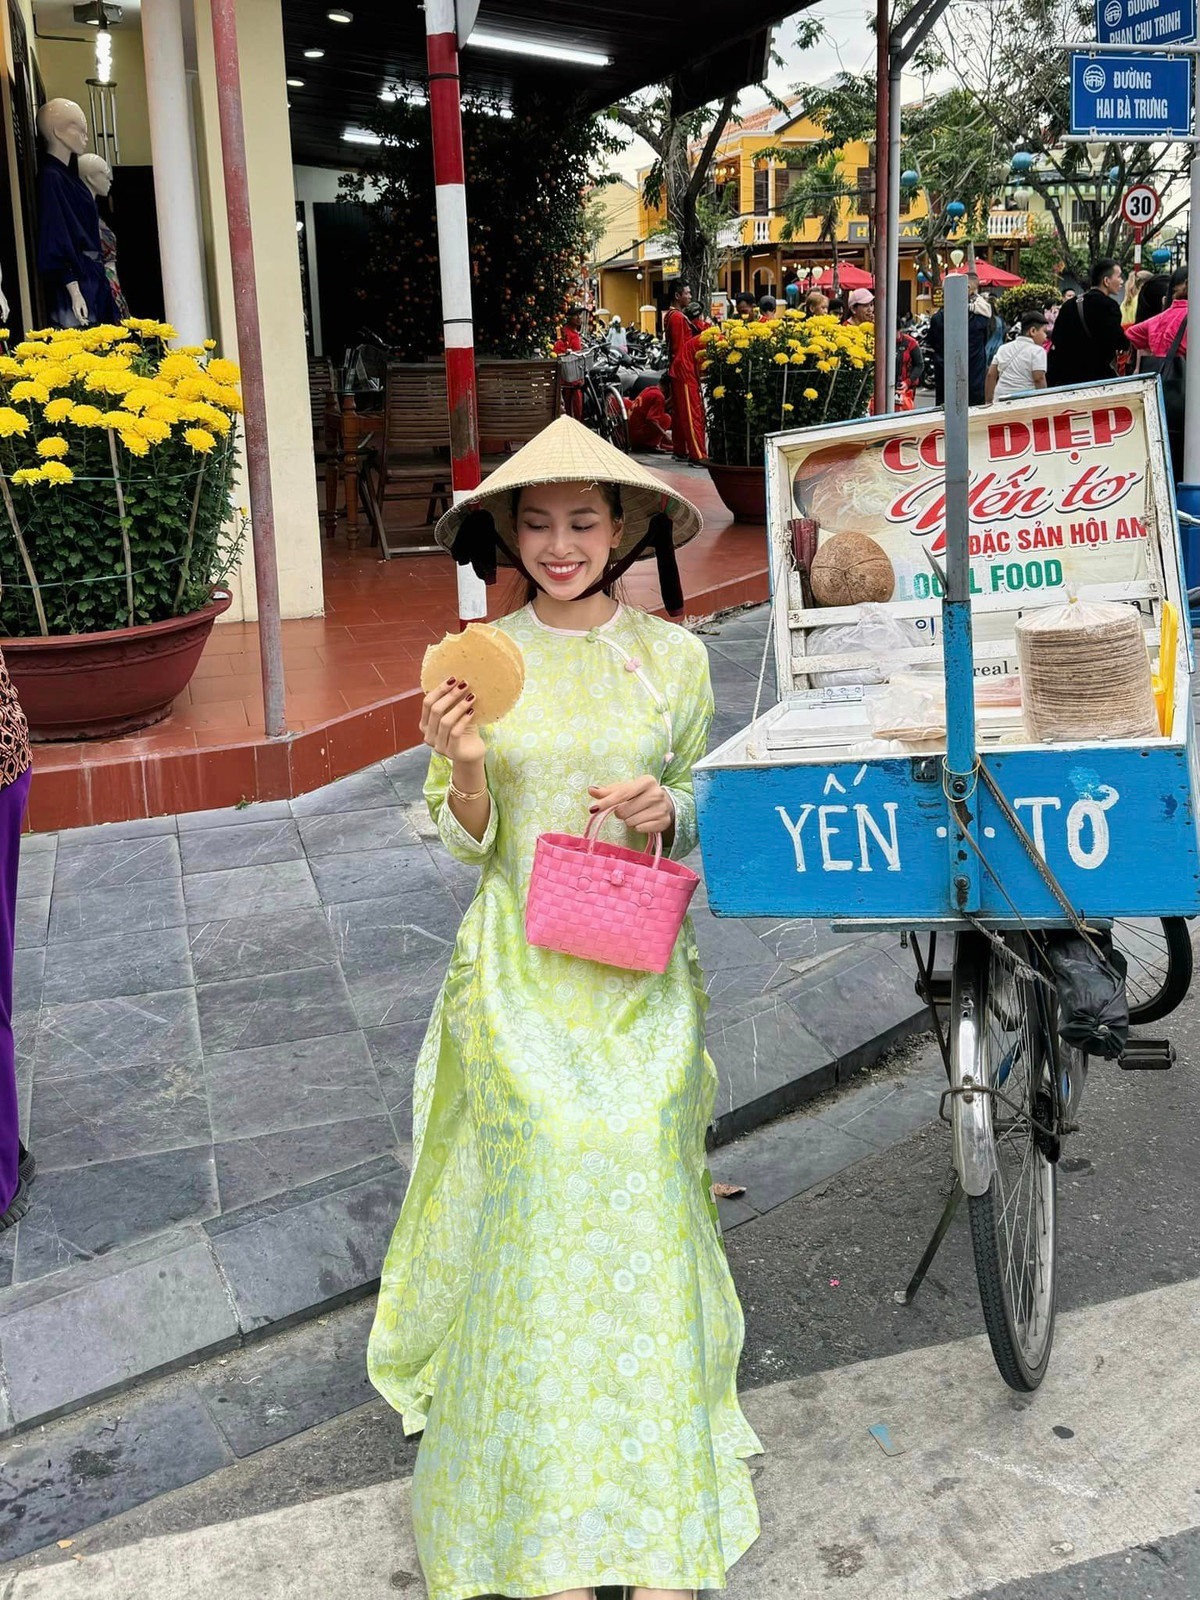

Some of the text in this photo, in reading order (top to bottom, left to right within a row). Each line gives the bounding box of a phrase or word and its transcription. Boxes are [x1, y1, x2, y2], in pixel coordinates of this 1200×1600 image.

[1110, 10, 1181, 44] PHAN CHU TRINH
[1113, 67, 1152, 89] ĐƯỜNG
[1096, 95, 1168, 119] HAI BÀ TRƯNG
[1130, 196, 1151, 216] 30
[987, 406, 1135, 462] DIỆP
[1061, 465, 1137, 508] tơ
[968, 516, 1147, 558] ĐẶC SẢN HỘI AN
[899, 559, 1063, 600] LOCL FOOD
[774, 764, 902, 873] YẾN
